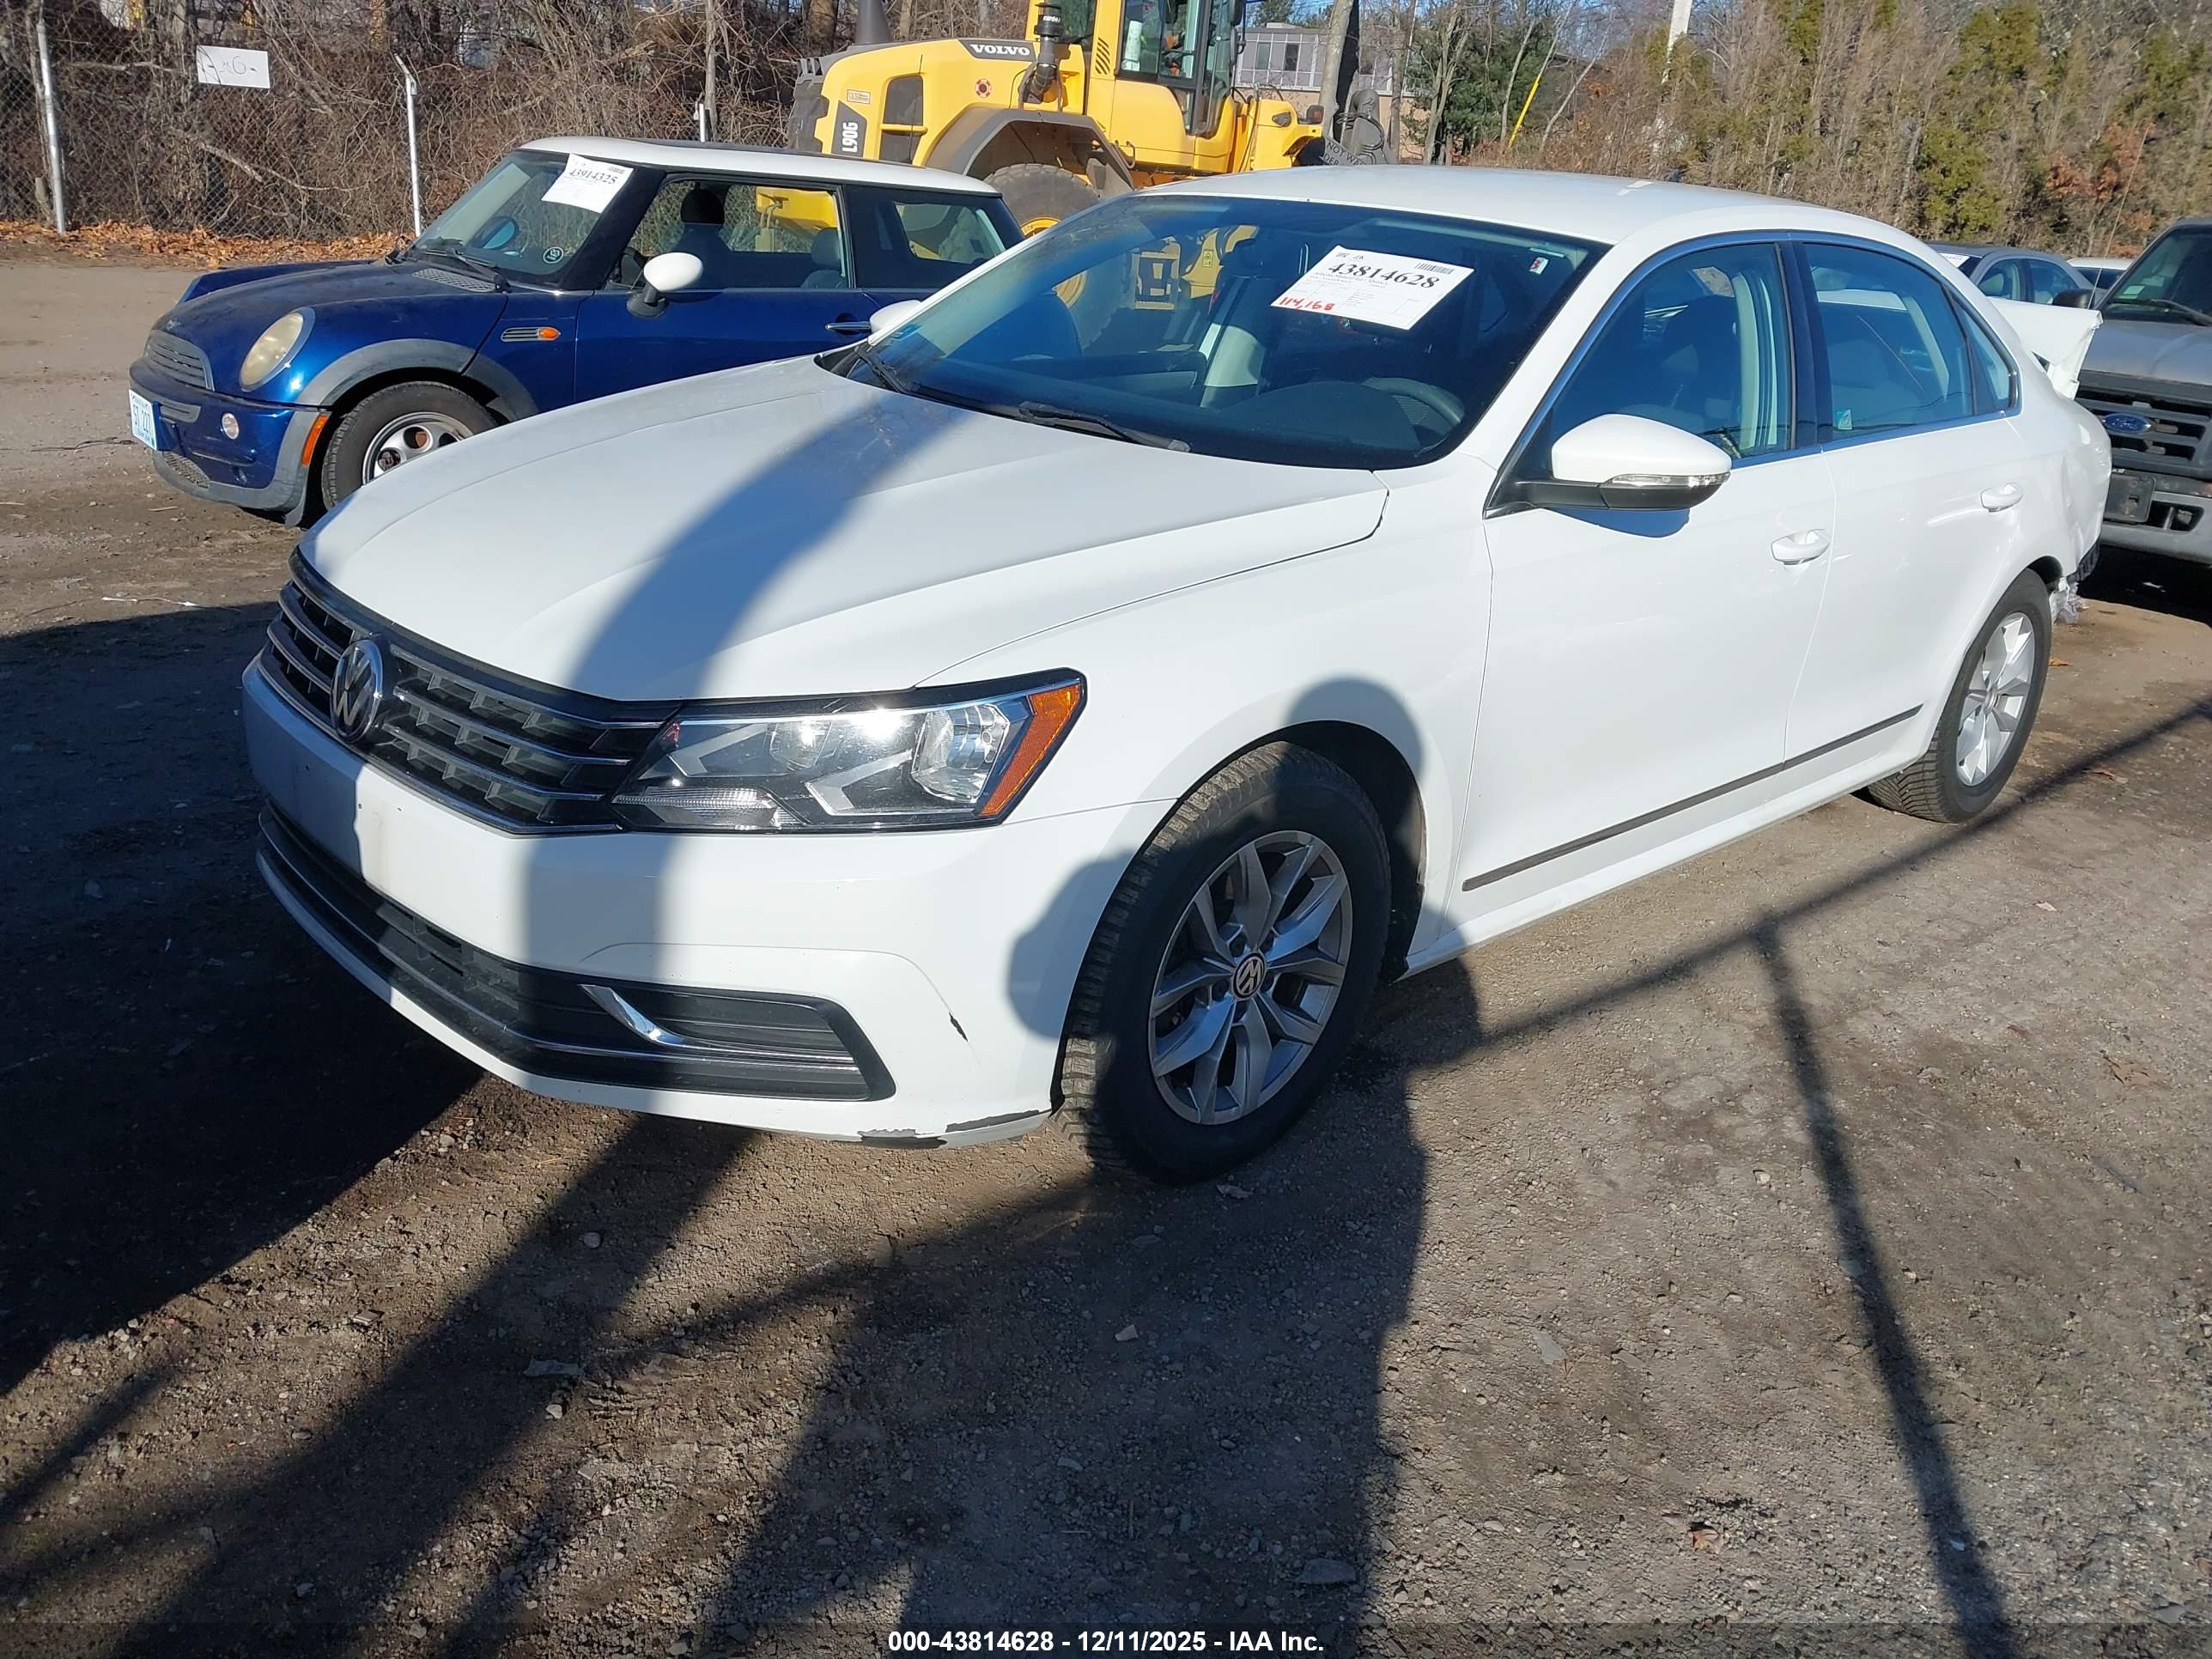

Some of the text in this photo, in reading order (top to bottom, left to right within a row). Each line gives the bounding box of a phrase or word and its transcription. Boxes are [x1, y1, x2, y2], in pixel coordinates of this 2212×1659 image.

[969, 44, 1030, 56] VOLVO
[842, 122, 858, 152] L90G
[1326, 141, 1345, 157] NOT
[568, 168, 618, 184] 43914325
[1328, 263, 1440, 289] 43814628
[1279, 296, 1335, 311] 114,168
